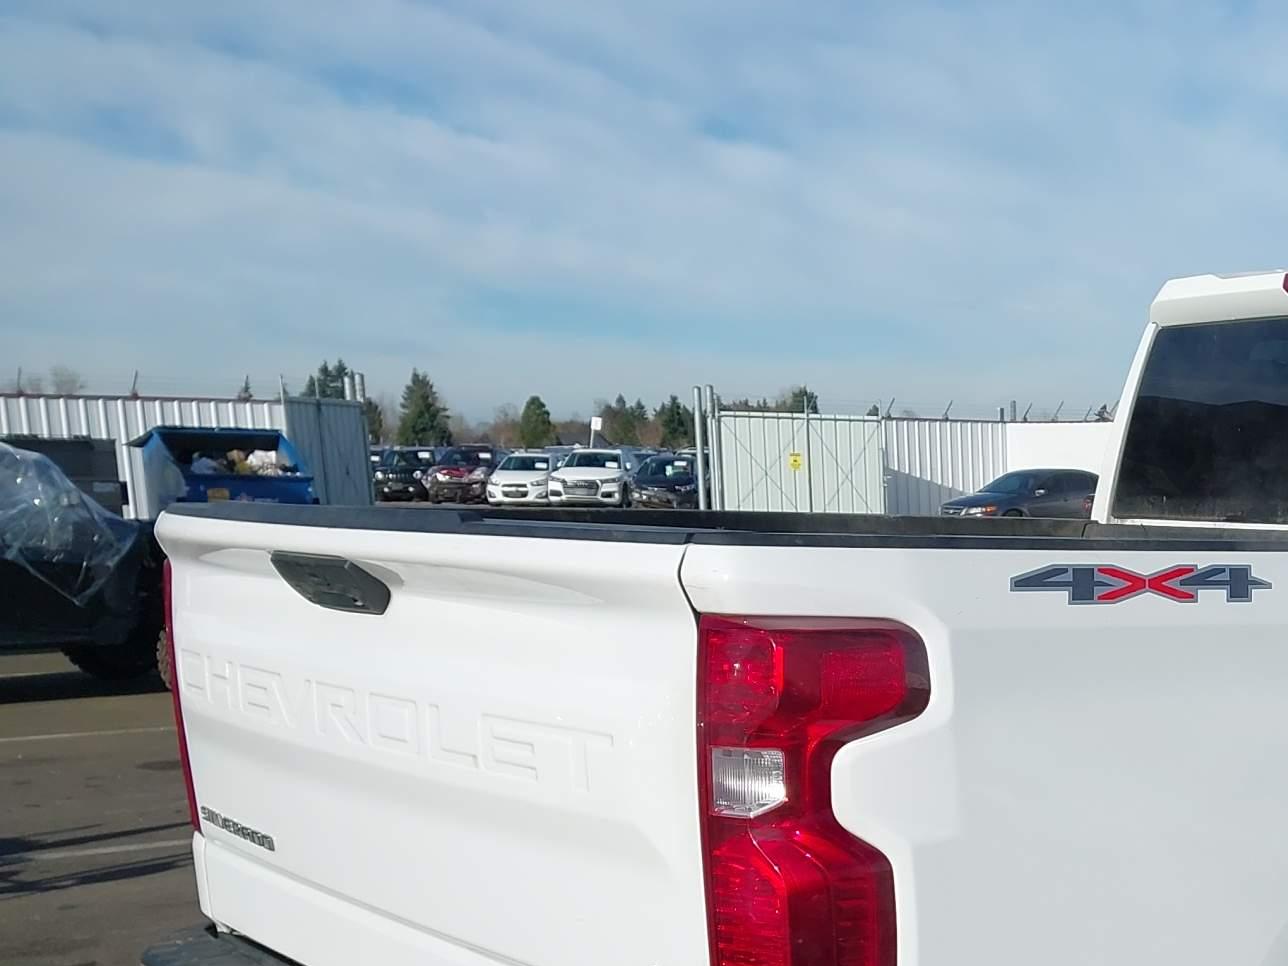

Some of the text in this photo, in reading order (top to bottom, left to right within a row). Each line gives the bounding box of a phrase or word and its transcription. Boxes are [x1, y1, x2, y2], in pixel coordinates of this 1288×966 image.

[1010, 564, 1272, 605] 4X4
[178, 648, 614, 793] CHEVROLET
[200, 805, 275, 851] SILVERADO
